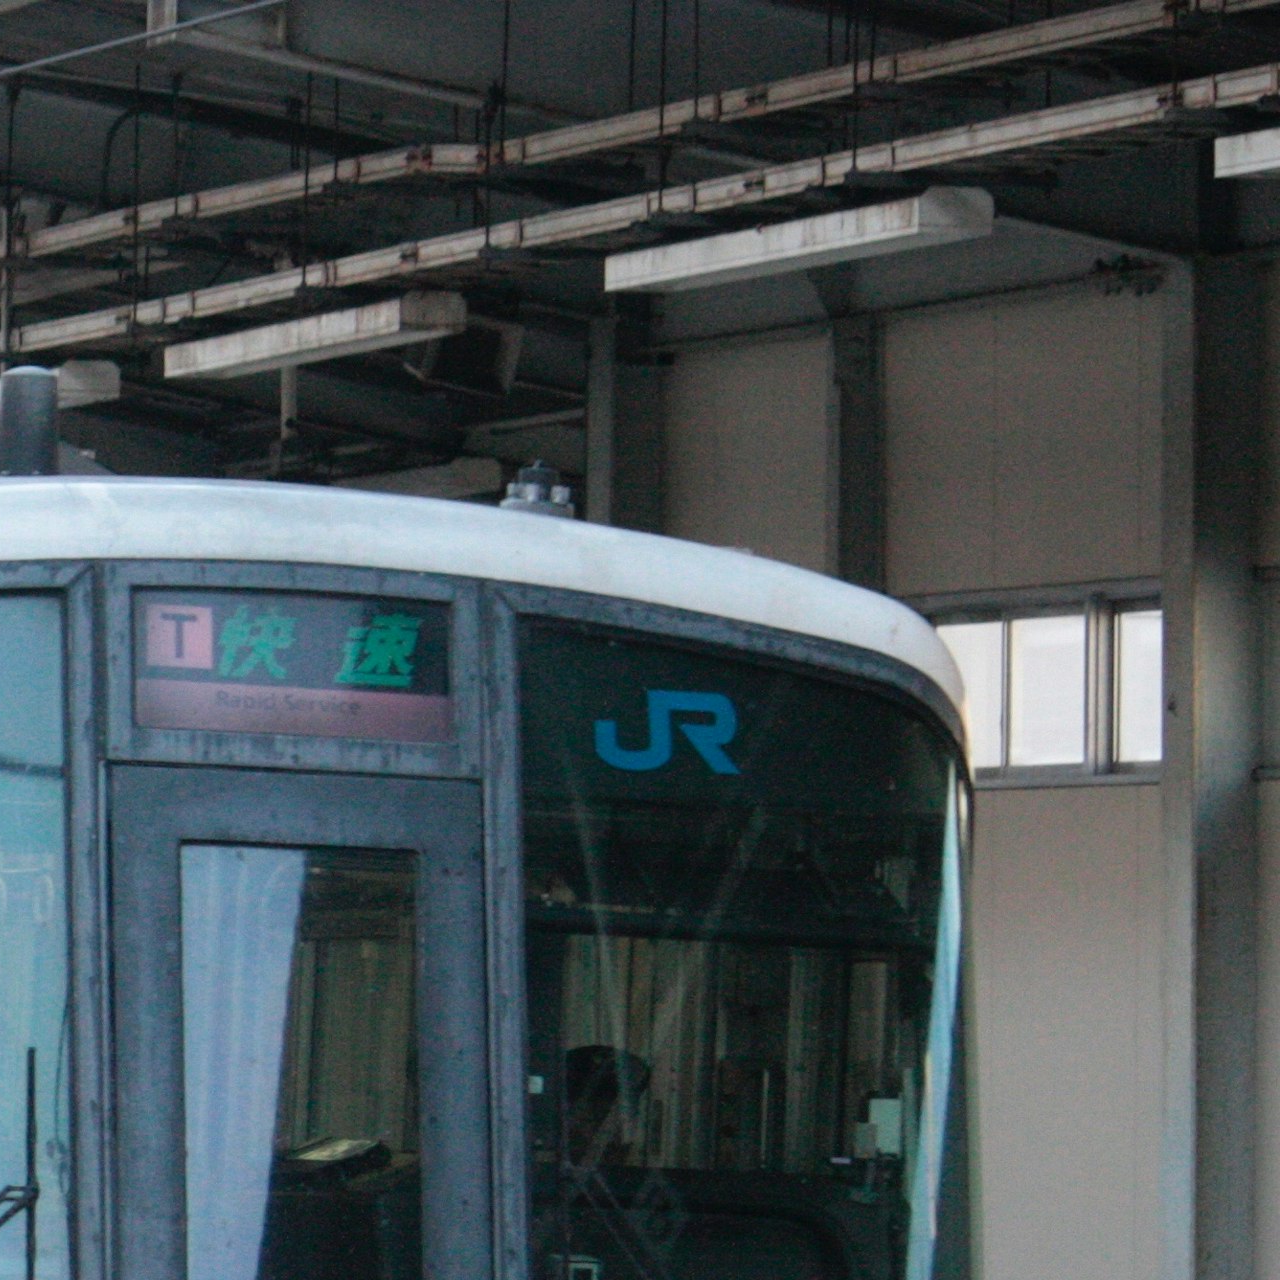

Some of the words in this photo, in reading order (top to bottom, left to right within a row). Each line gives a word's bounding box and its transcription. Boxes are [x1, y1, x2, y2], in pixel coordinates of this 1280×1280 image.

[159, 612, 198, 659] T
[218, 603, 422, 688] 快速
[594, 689, 742, 775] JR
